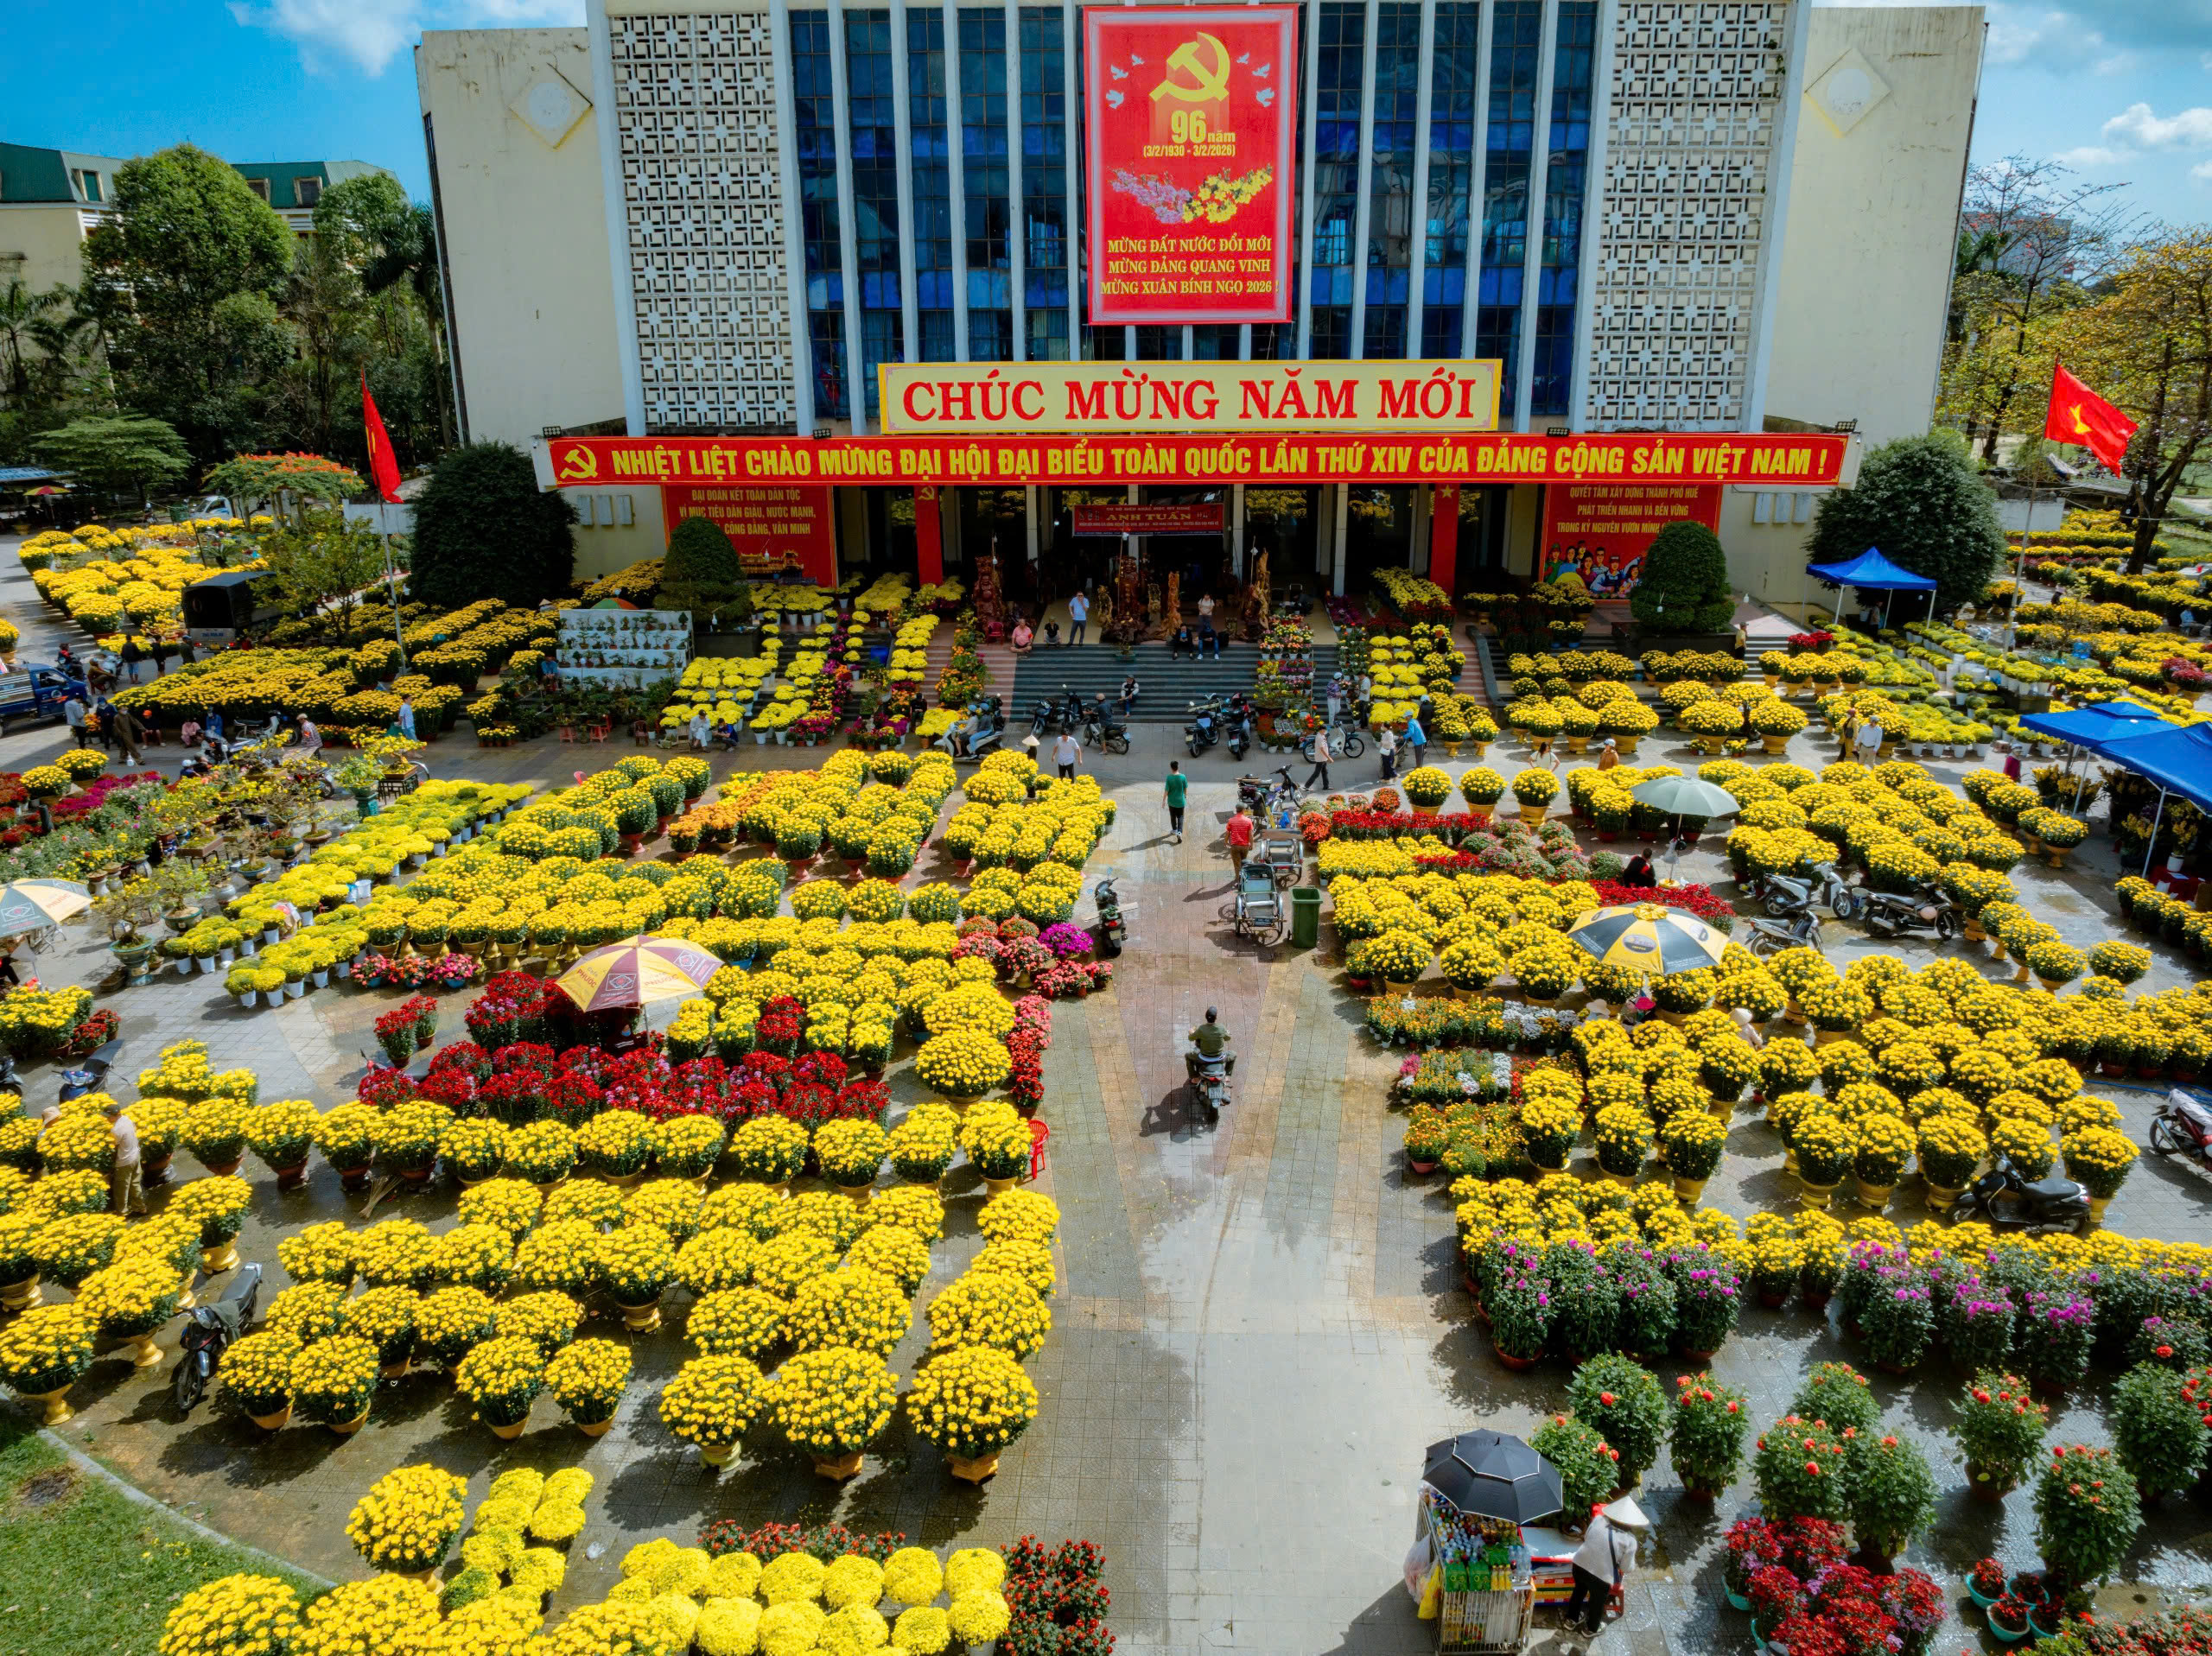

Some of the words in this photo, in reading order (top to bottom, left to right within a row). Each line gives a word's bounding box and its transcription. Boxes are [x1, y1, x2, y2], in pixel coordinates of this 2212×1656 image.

[1171, 110, 1207, 144] 96
[1207, 130, 1236, 143] năm
[1143, 145, 1185, 158] (3/2/1930
[1193, 144, 1236, 157] 3/2/2026)
[1108, 236, 1147, 253] MỪNG
[1149, 233, 1177, 252] ĐẤT
[1179, 235, 1216, 252] NƯỚC
[1219, 232, 1243, 251] ĐỔI
[1246, 234, 1272, 251] MỚI
[1108, 257, 1147, 274] MỪNG
[1150, 255, 1187, 273] ĐẢNG
[1190, 259, 1236, 276] QUANG
[1238, 258, 1271, 272] VINH
[1100, 278, 1140, 295] MỪNG
[1141, 277, 1178, 295] XUÂN
[1180, 276, 1213, 294] BÍNH
[1216, 281, 1243, 296] NGỌ
[1246, 280, 1272, 293] 2026
[903, 369, 1046, 422] CHÚC
[1065, 368, 1219, 421] MỪNG
[1239, 367, 1359, 419] NĂM
[1376, 366, 1477, 419] MỚI
[611, 444, 681, 481] NHIỆT
[690, 444, 738, 481] LIỆT
[745, 444, 811, 476] CHÀO
[819, 443, 893, 475] MỪNG
[899, 448, 942, 481] ĐẠI
[950, 443, 990, 481] HỘI
[997, 448, 1039, 481] ĐẠI
[1048, 438, 1103, 475] BIỂU
[1111, 442, 1177, 474] TOÀN
[1185, 439, 1251, 477] QUỐC
[1260, 439, 1308, 473] LẦN
[1316, 442, 1367, 473] THỨ
[1370, 446, 1413, 473] XIV
[1419, 437, 1469, 473] CỦA
[1476, 437, 1548, 473] ĐẢNG
[1554, 442, 1624, 479] CỘNG
[1631, 438, 1686, 474] SẢN
[1694, 442, 1746, 480] VIỆT
[1751, 448, 1812, 475] NAM
[1817, 448, 1827, 475] !
[691, 488, 705, 504] ĐẠI
[707, 487, 728, 501] ĐOÀN
[729, 486, 744, 501] KẾT
[746, 487, 766, 501] TOÀN
[767, 487, 784, 501] DÂN
[786, 486, 801, 504] TỘC
[1570, 484, 1592, 498] QUYẾT
[1593, 485, 1608, 498] TÂM
[1610, 485, 1623, 498] XÂY
[1624, 486, 1644, 500] DỰNG
[1646, 485, 1669, 498] THÀNH
[1669, 485, 1684, 498] PHỐ
[1685, 485, 1699, 498] HUẾ
[708, 504, 725, 518] TIÊU
[726, 504, 743, 518] DÂN
[744, 504, 765, 519] GIÀU,
[766, 503, 789, 518] NƯỚC
[791, 505, 817, 520] MẠNH,
[1106, 513, 1141, 522] ANH
[1145, 511, 1192, 521] TUẤN
[1578, 503, 1595, 516] PHÁT
[1618, 504, 1643, 516] NHANH
[1644, 503, 1654, 516] VÀ
[1670, 504, 1689, 517] VỮNG
[724, 521, 746, 535] CÔNG
[790, 523, 810, 535] MINH
[1557, 522, 1580, 533] TRONG
[1580, 519, 1591, 533] KỶ
[1592, 520, 1620, 533] NGUYÊN
[1622, 522, 1640, 533] VƯƠN
[1642, 520, 1660, 533] MÌNH
